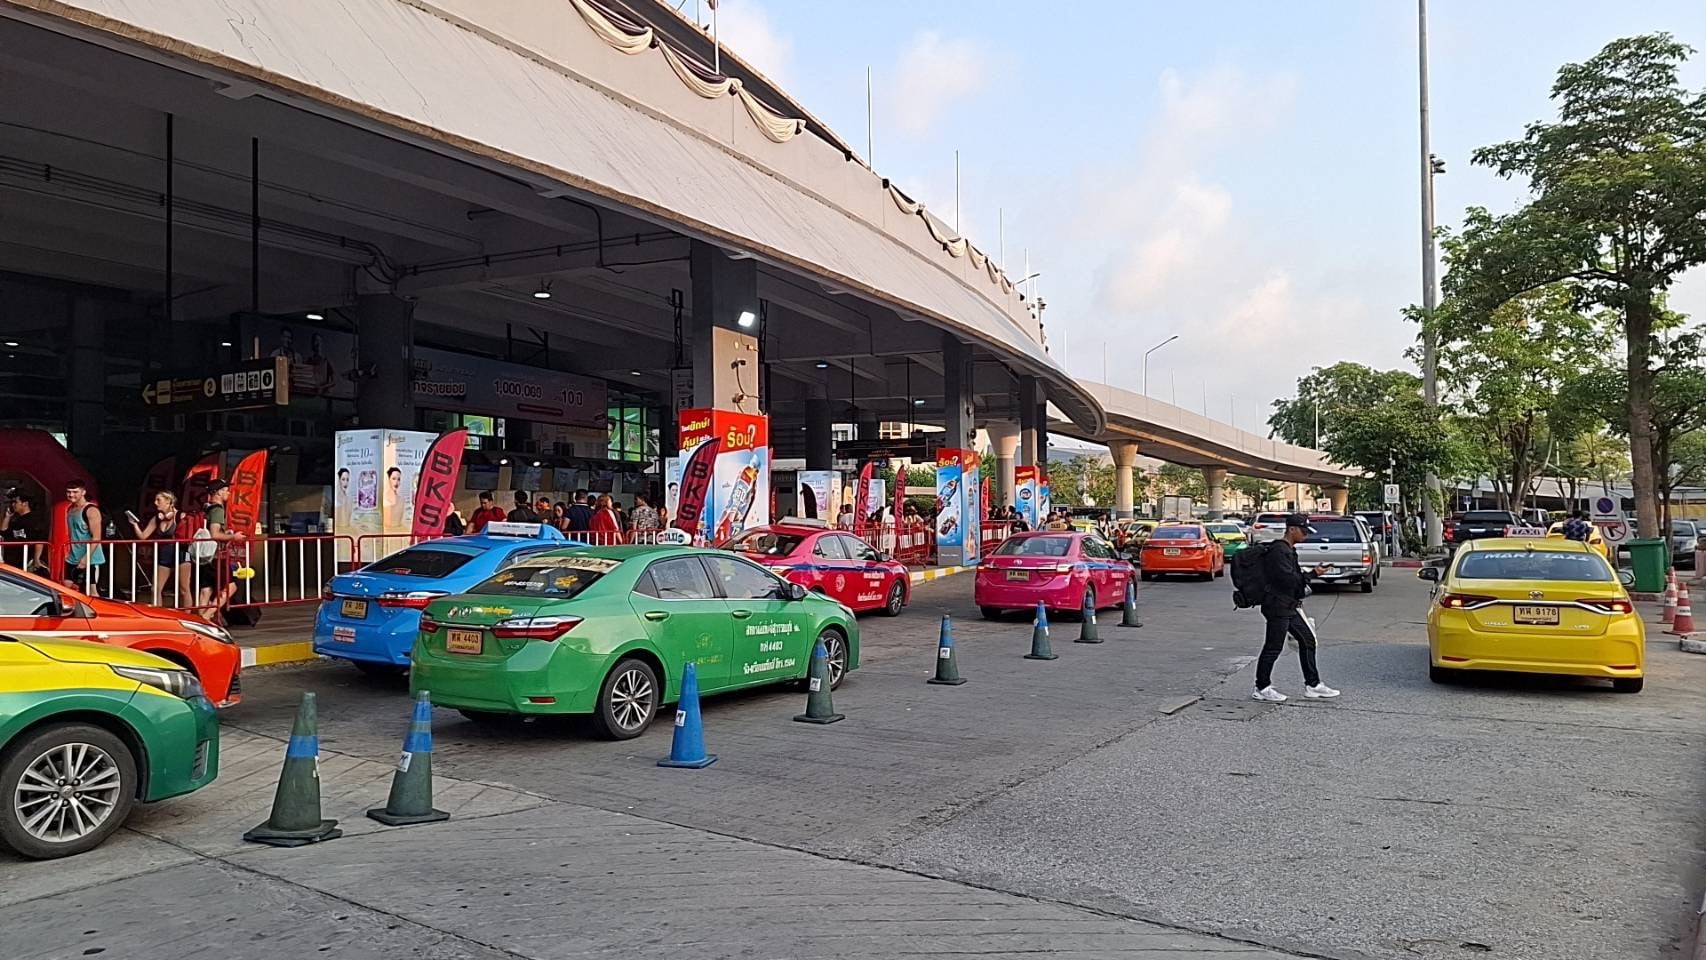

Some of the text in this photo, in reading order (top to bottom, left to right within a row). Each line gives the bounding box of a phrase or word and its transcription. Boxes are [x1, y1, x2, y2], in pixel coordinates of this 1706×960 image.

[494, 380, 542, 399] 1,000,000
[231, 470, 256, 528] BKS
[419, 450, 454, 528] BKS
[680, 460, 709, 521] BKS
[856, 476, 870, 523] BKS
[664, 532, 678, 542] TAXI
[1512, 528, 1541, 536] TAXI
